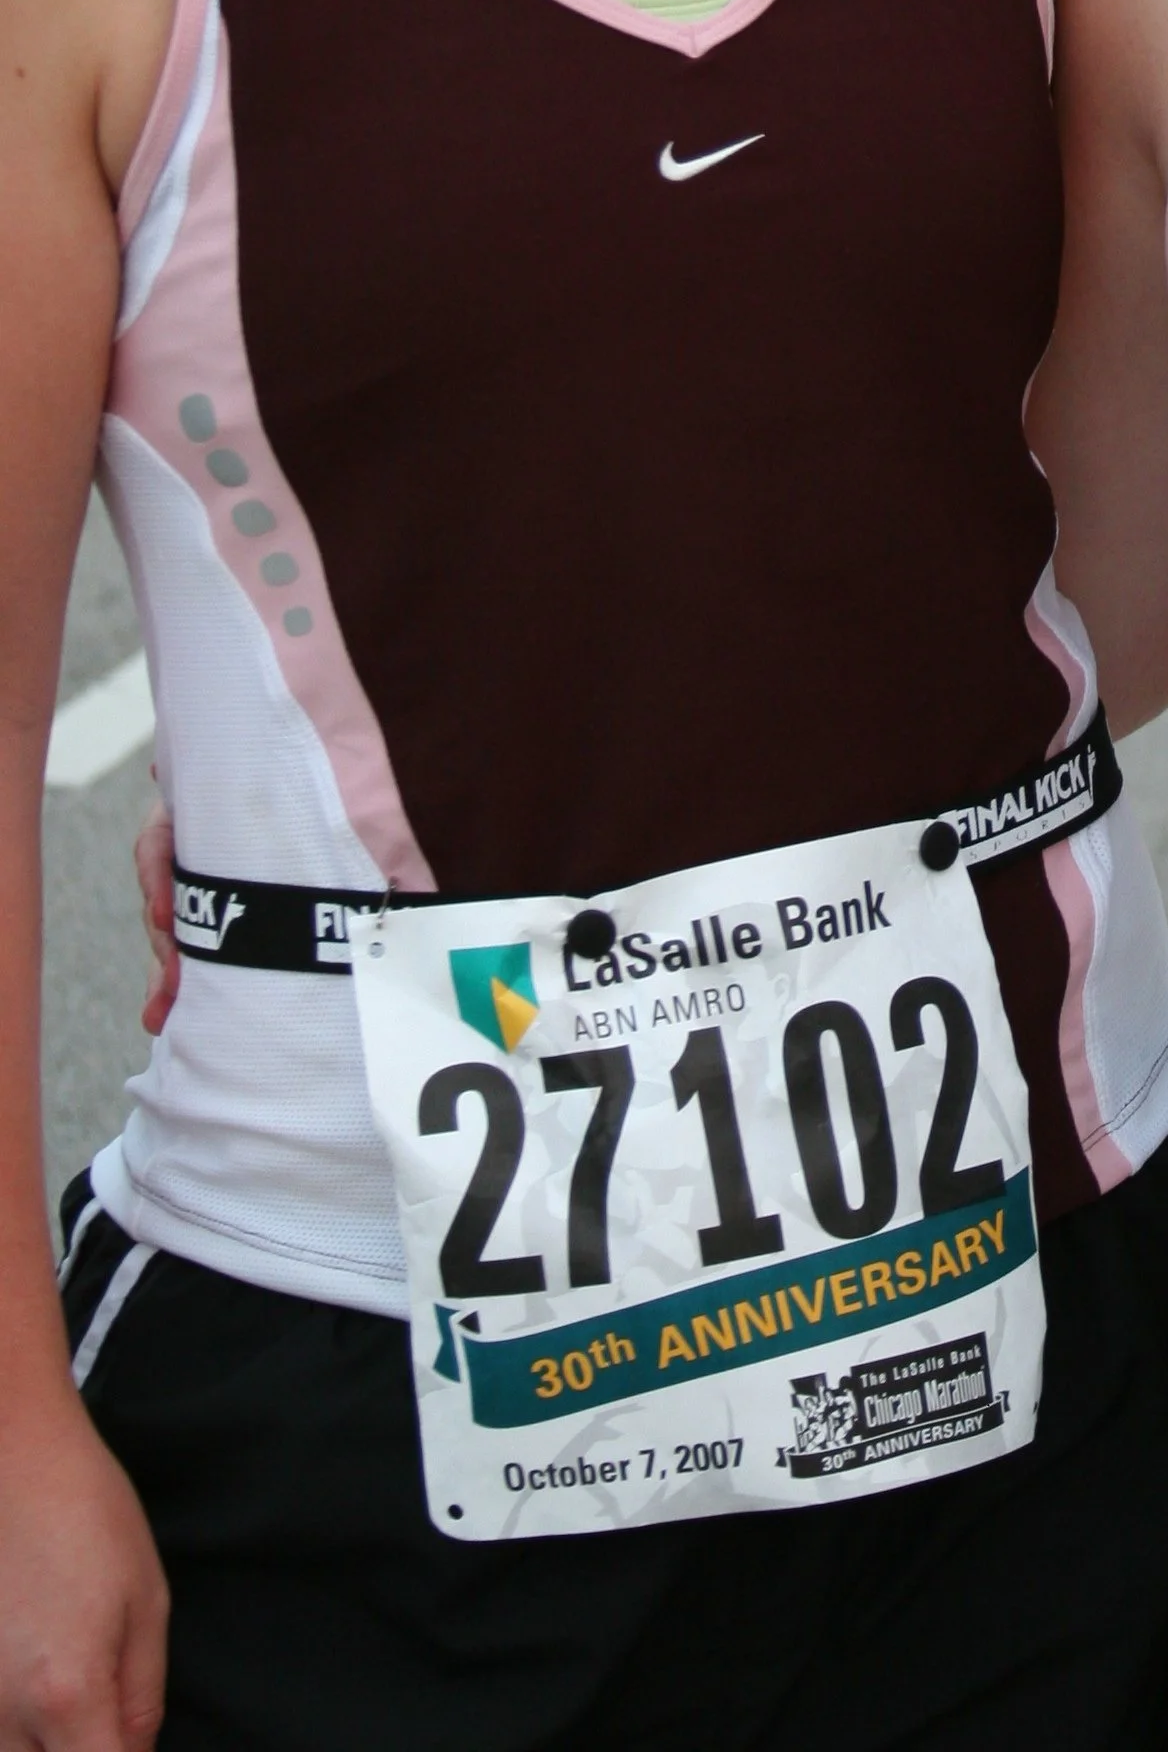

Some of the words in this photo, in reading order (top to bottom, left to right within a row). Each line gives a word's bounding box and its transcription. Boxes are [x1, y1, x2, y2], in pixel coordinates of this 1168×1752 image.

[938, 785, 1034, 845] FINAL
[1034, 753, 1086, 813] KICK
[563, 914, 763, 992] LaSalle
[775, 879, 892, 952] Bank
[574, 1004, 639, 1043] ABN
[651, 983, 746, 1029] AMRO
[417, 974, 1009, 1299] 27102
[529, 1333, 637, 1400] 30th
[656, 1209, 1006, 1370] ANNIVERSARY
[859, 1371, 888, 1388] The
[892, 1356, 946, 1381] LaSalle
[949, 1344, 983, 1365] Bank
[863, 1388, 924, 1428] Chicago
[923, 1370, 987, 1413] Marathon
[502, 1456, 631, 1492] October
[638, 1448, 669, 1481] 7,
[673, 1437, 745, 1475] 2007
[821, 1448, 857, 1473] 30th
[863, 1413, 985, 1462] ANNIVERSARY
